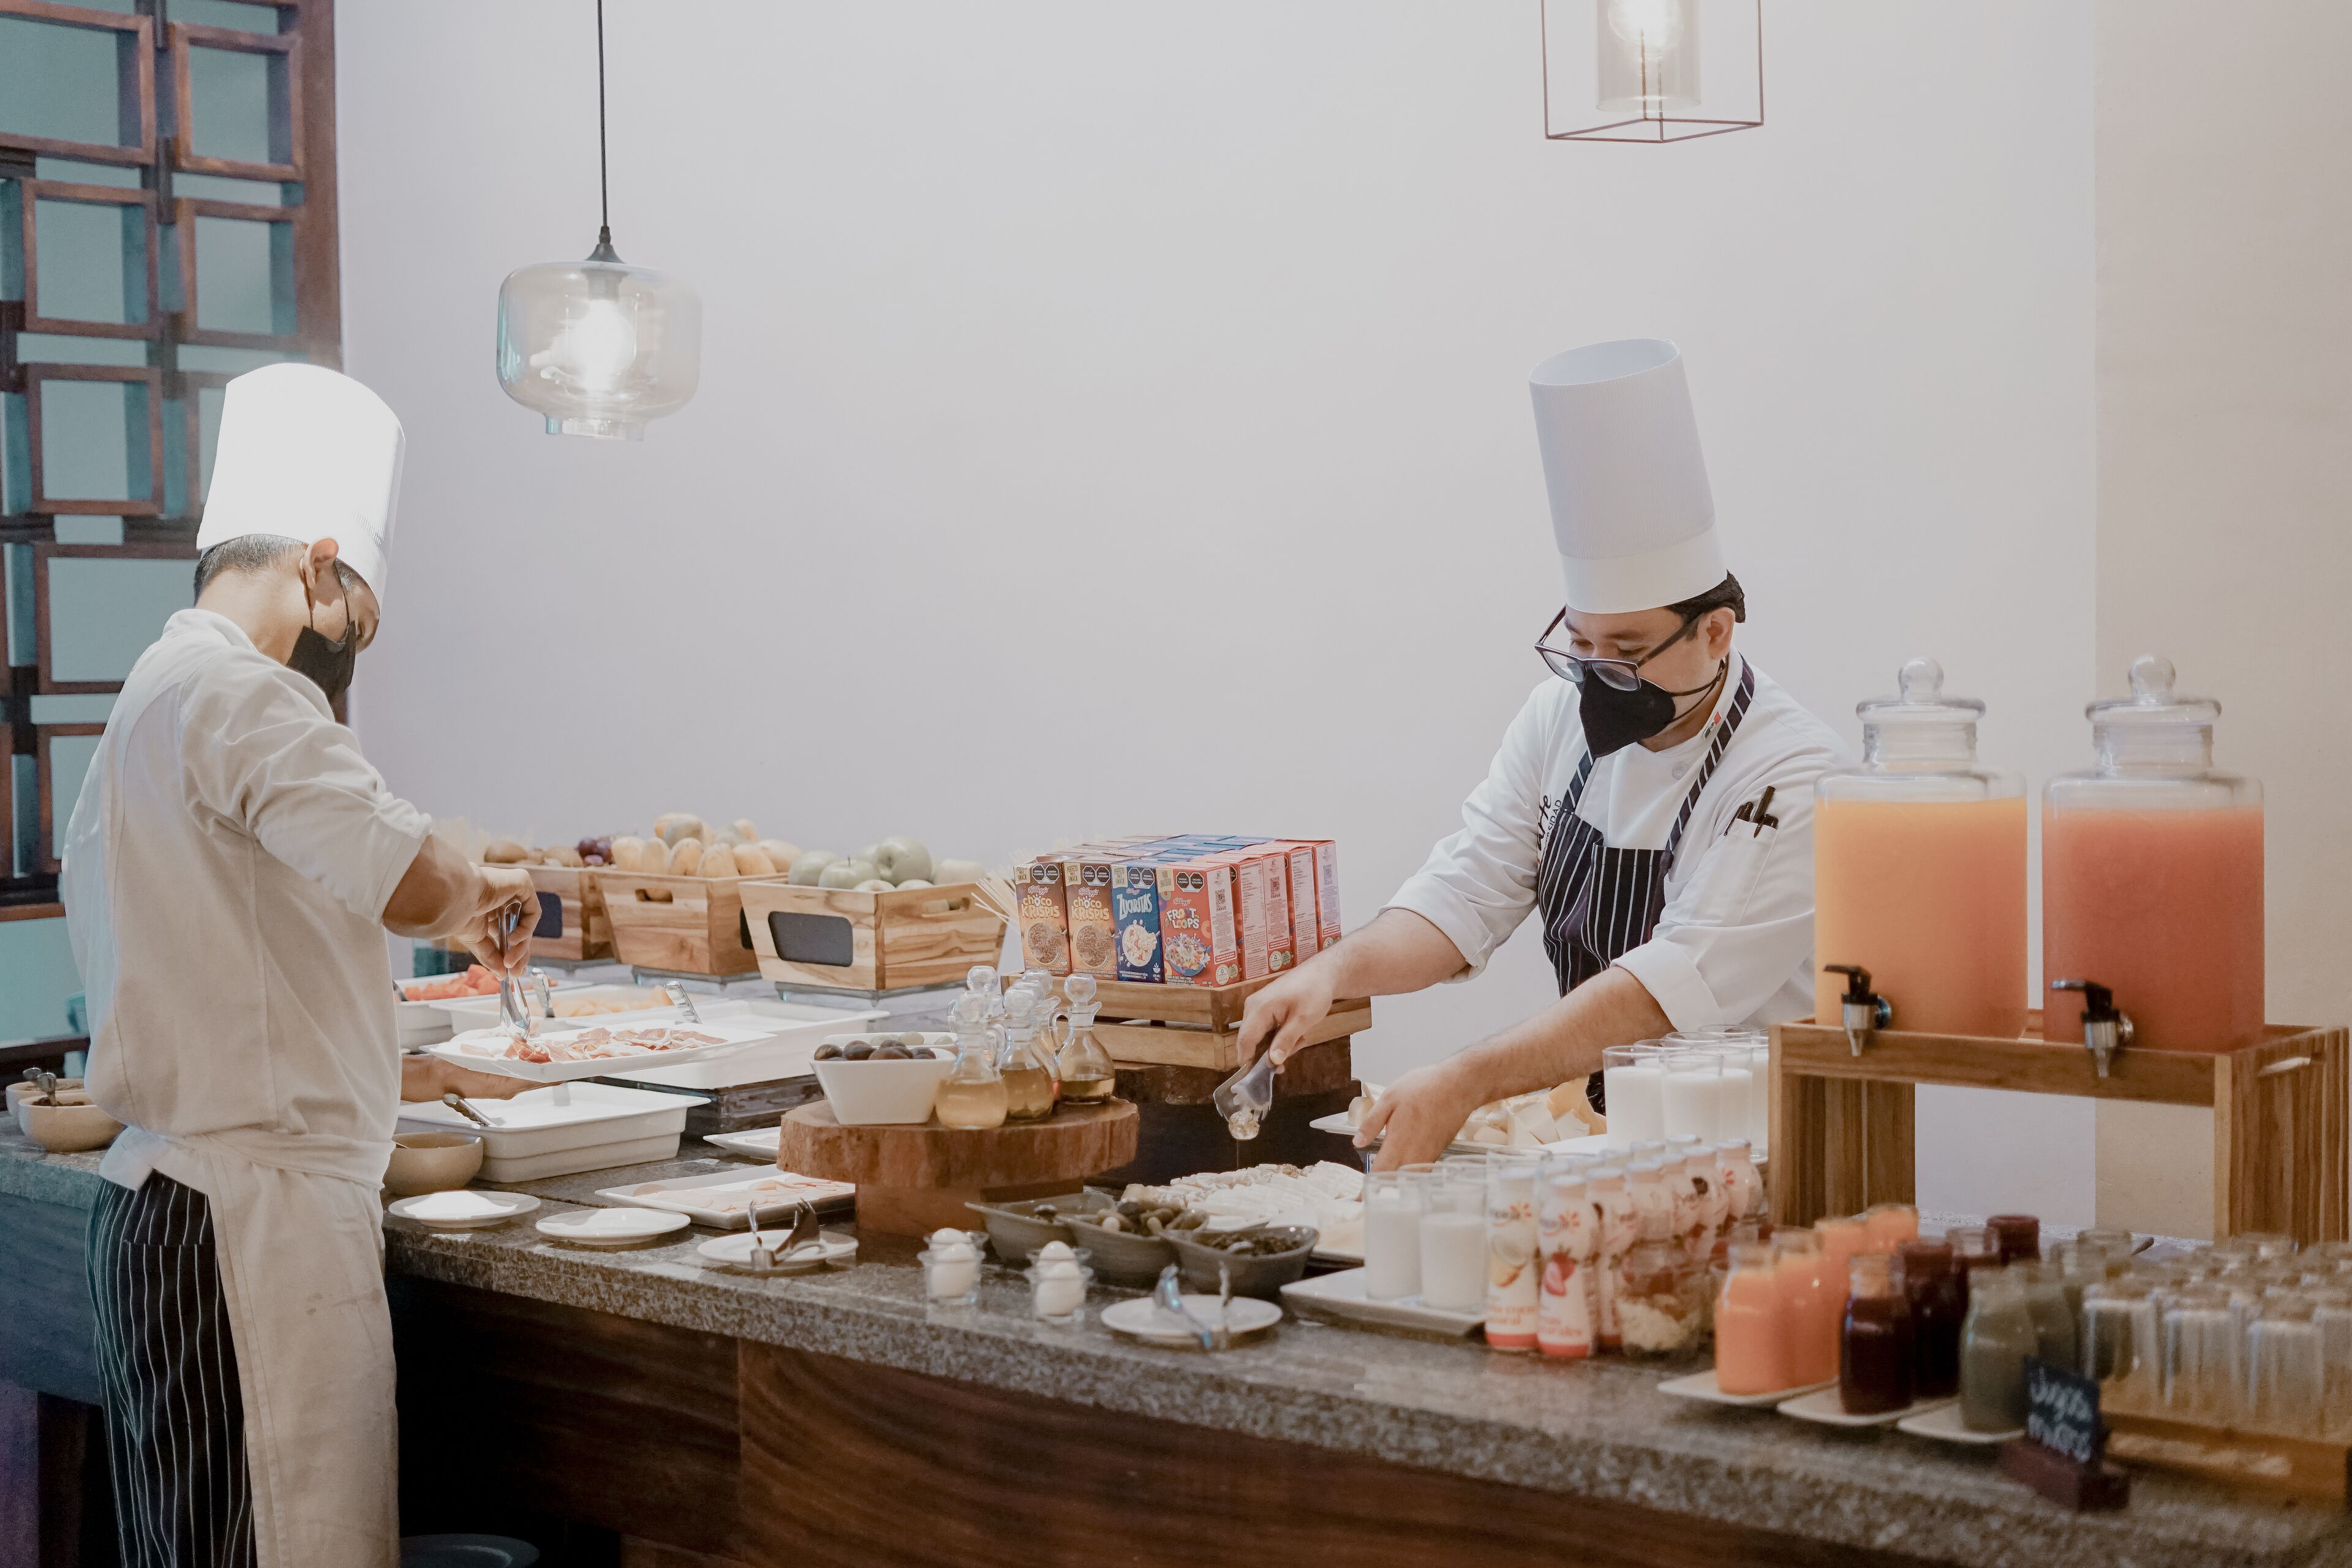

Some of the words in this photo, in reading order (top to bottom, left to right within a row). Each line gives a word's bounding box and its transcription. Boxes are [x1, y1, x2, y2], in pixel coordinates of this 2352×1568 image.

[1021, 903, 1060, 919] KRISPIS
[1071, 905, 1110, 921] KRISPIS
[1117, 893, 1153, 921] ZUCARITAS
[1172, 918, 1199, 929] LOOPS
